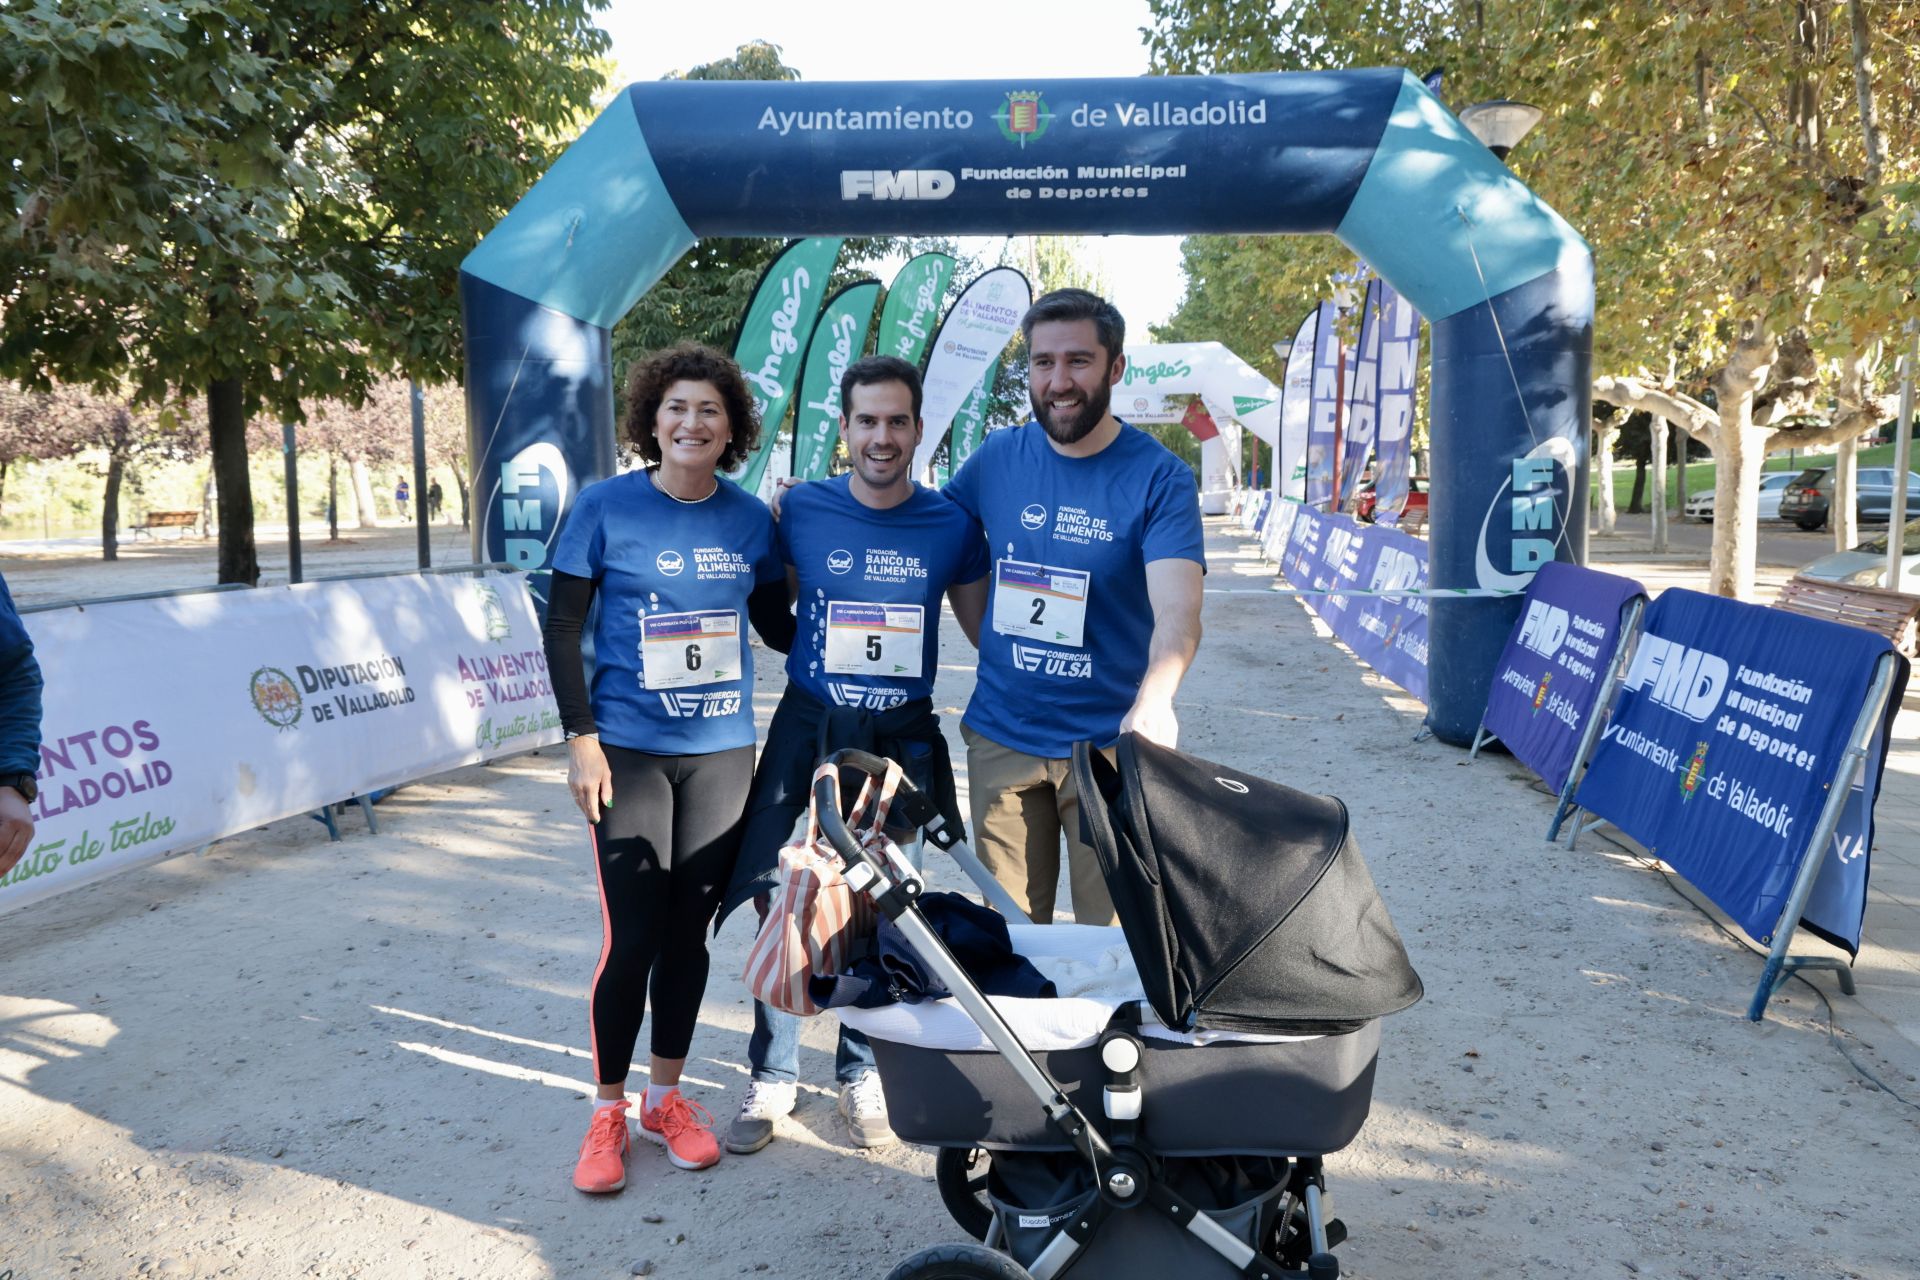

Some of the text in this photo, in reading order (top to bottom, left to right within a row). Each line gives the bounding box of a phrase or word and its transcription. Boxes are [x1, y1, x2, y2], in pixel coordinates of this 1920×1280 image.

[757, 99, 1267, 136] Ayuntamiento de Valladolid
[961, 164, 1187, 180] Fundación Municipal
[840, 169, 956, 200] FMD
[1006, 185, 1149, 200] de Deportes
[962, 299, 1018, 318] ALIMENTOS
[501, 462, 547, 570] FMD
[1059, 505, 1087, 515] FUNDACIÓN
[1511, 458, 1556, 571] FMD
[1057, 512, 1107, 530] BANCO DE
[1054, 523, 1113, 542] ALIMENTOS
[694, 554, 743, 563] BANCO DE
[697, 563, 750, 573] ALIMENTOS
[866, 555, 920, 567] BANCO DE
[865, 565, 927, 578] ALIMENTOS
[1030, 598, 1046, 625] 2
[1517, 599, 1569, 660] FMD
[686, 644, 701, 671] 6
[866, 635, 881, 661] 5
[1047, 650, 1092, 662] COMERCIAL
[296, 654, 406, 694] DIPUTACIÓN
[458, 650, 546, 684] ALIMENTO
[1045, 659, 1092, 678] ULSA
[1624, 632, 1729, 723] FMD
[703, 690, 741, 700] COMERCIAL
[868, 687, 908, 695] COMERCIAL
[1735, 665, 1812, 704] Fundación
[311, 686, 415, 723] DE VALLADOLID
[466, 688, 485, 709] DE
[702, 699, 740, 718] ULSA
[865, 695, 908, 711] ULSA
[1726, 689, 1803, 732] Municipal
[1716, 715, 1736, 736] de
[1707, 771, 1726, 800] de
[69, 830, 105, 865] de
[109, 812, 176, 852] todos
